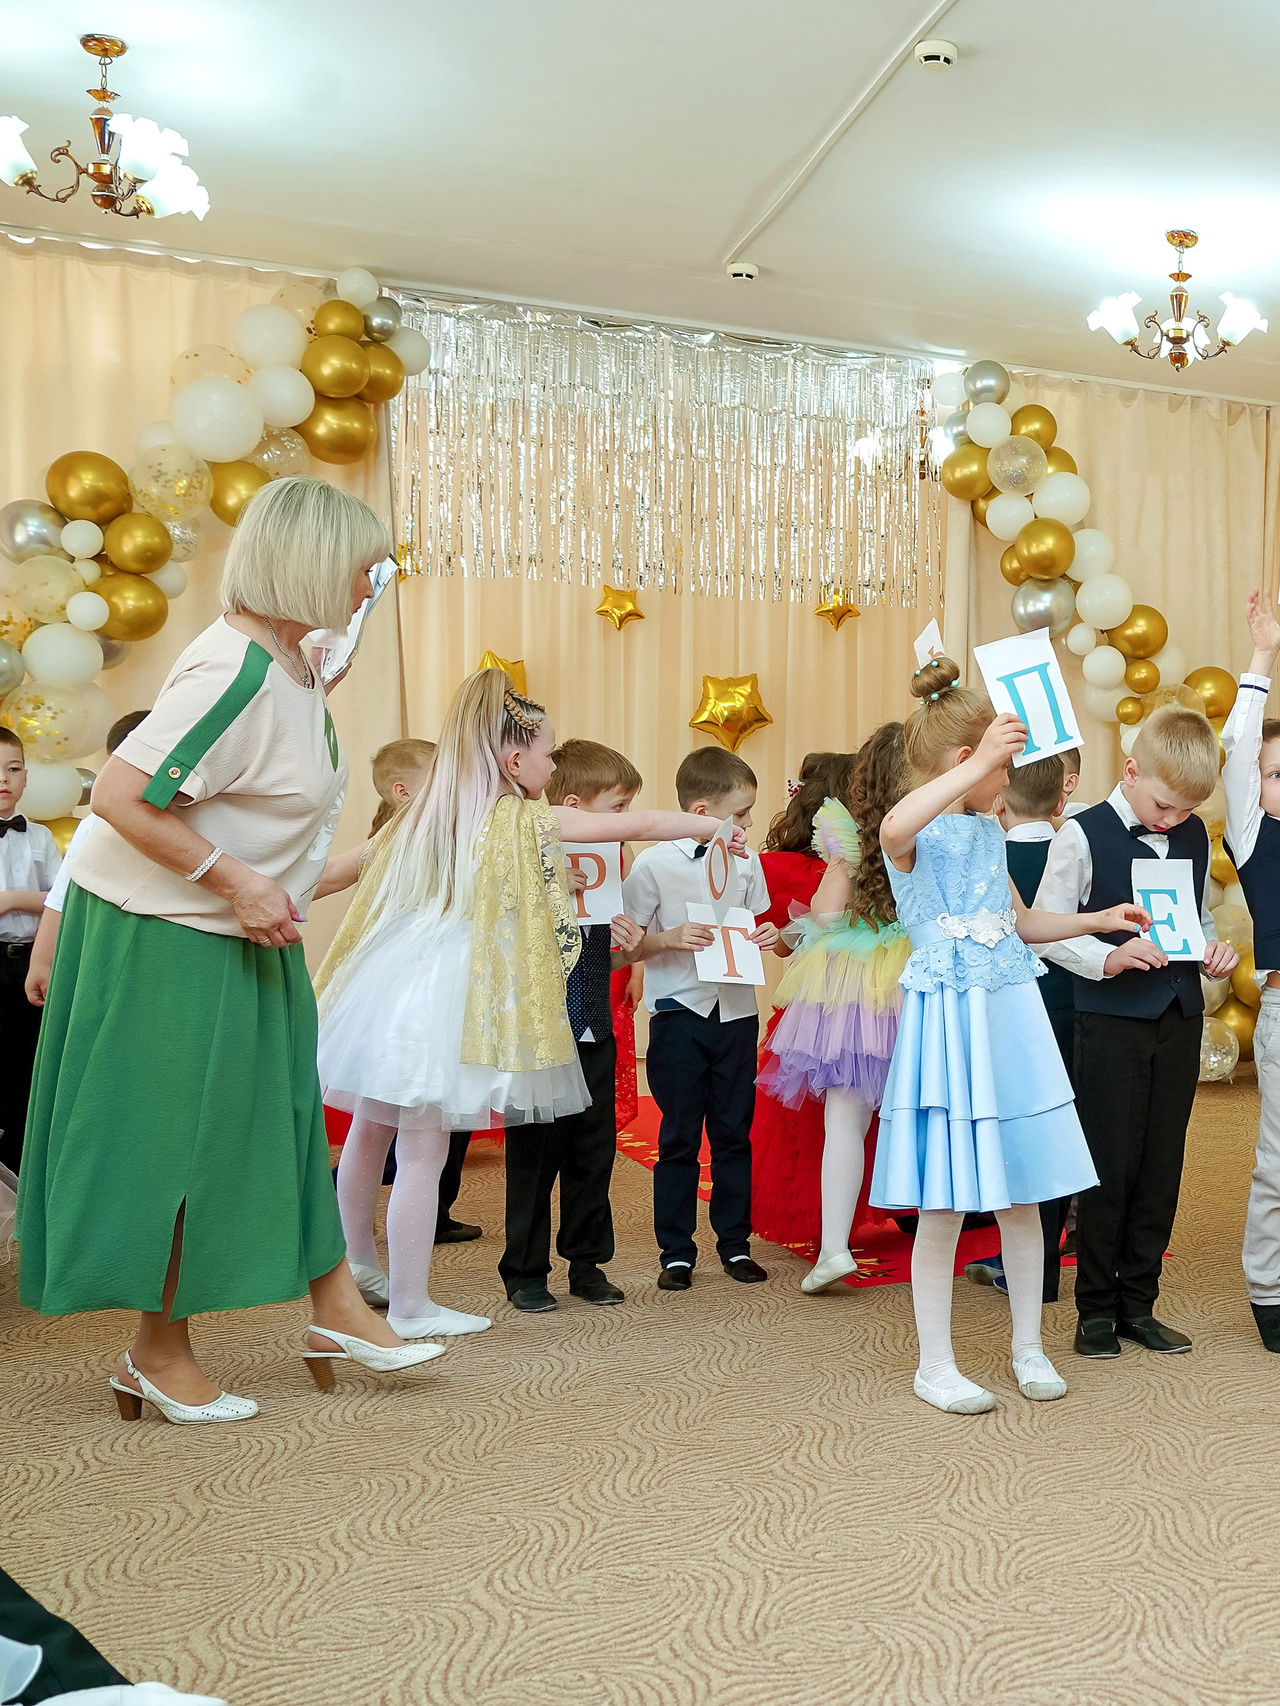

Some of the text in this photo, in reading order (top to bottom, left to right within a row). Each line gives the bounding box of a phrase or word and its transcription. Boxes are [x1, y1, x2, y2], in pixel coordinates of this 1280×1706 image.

[996, 661, 1074, 757] П
[566, 852, 607, 918] Р
[701, 924, 753, 979] Т
[1136, 889, 1192, 955] Е
